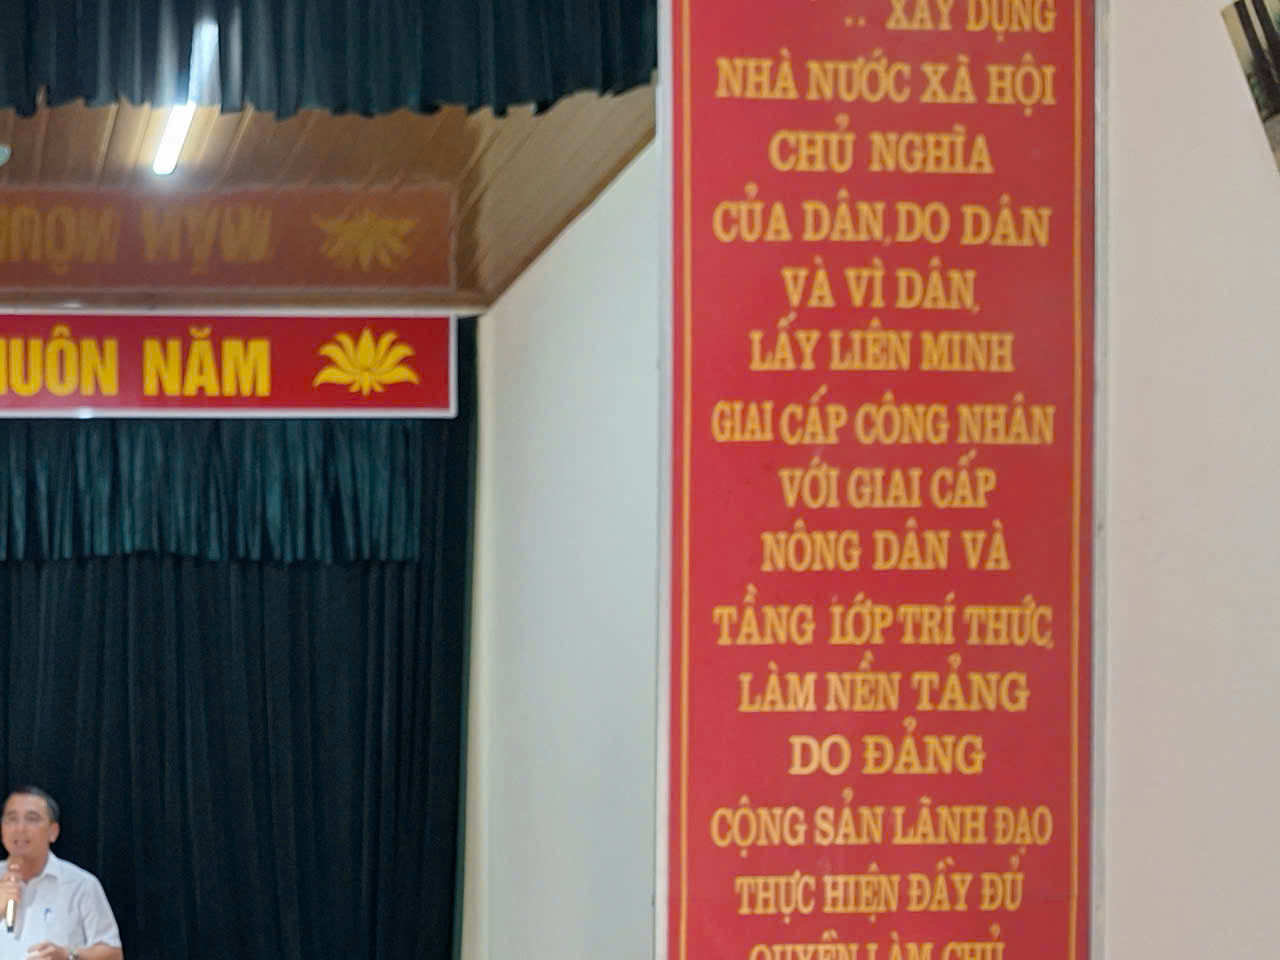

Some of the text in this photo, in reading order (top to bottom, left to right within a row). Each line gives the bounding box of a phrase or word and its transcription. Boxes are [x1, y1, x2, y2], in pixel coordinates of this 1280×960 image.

[715, 48, 798, 99] NHÀ
[806, 48, 912, 103] NƯỚC
[986, 52, 1056, 116] HỘI
[768, 114, 855, 173] CHỦ
[712, 184, 792, 242] CỦA
[896, 201, 950, 243] DO
[960, 195, 1052, 247] DÂN
[782, 257, 834, 308] VÀ
[846, 257, 885, 307] VÌ
[143, 326, 271, 399] NĂM
[749, 312, 1014, 373] LẤY LIÊN MINH
[712, 385, 1056, 445] GIAI CẤP CÔNG NHÂN
[778, 450, 997, 509] VỚI GIAI CẤP
[762, 519, 1010, 571] NÔNG DÂN VÀ
[829, 594, 895, 645] LỚP
[898, 593, 956, 646] TRÍ
[738, 662, 816, 712] LÀM
[912, 654, 1030, 712] TẢNG
[789, 717, 986, 775] DO ĐẢNG
[710, 788, 1053, 856] CỘNG SẢN LÃNH ĐẠO
[735, 856, 1025, 924] THỰC HIỆN ĐẦY ĐỦ
